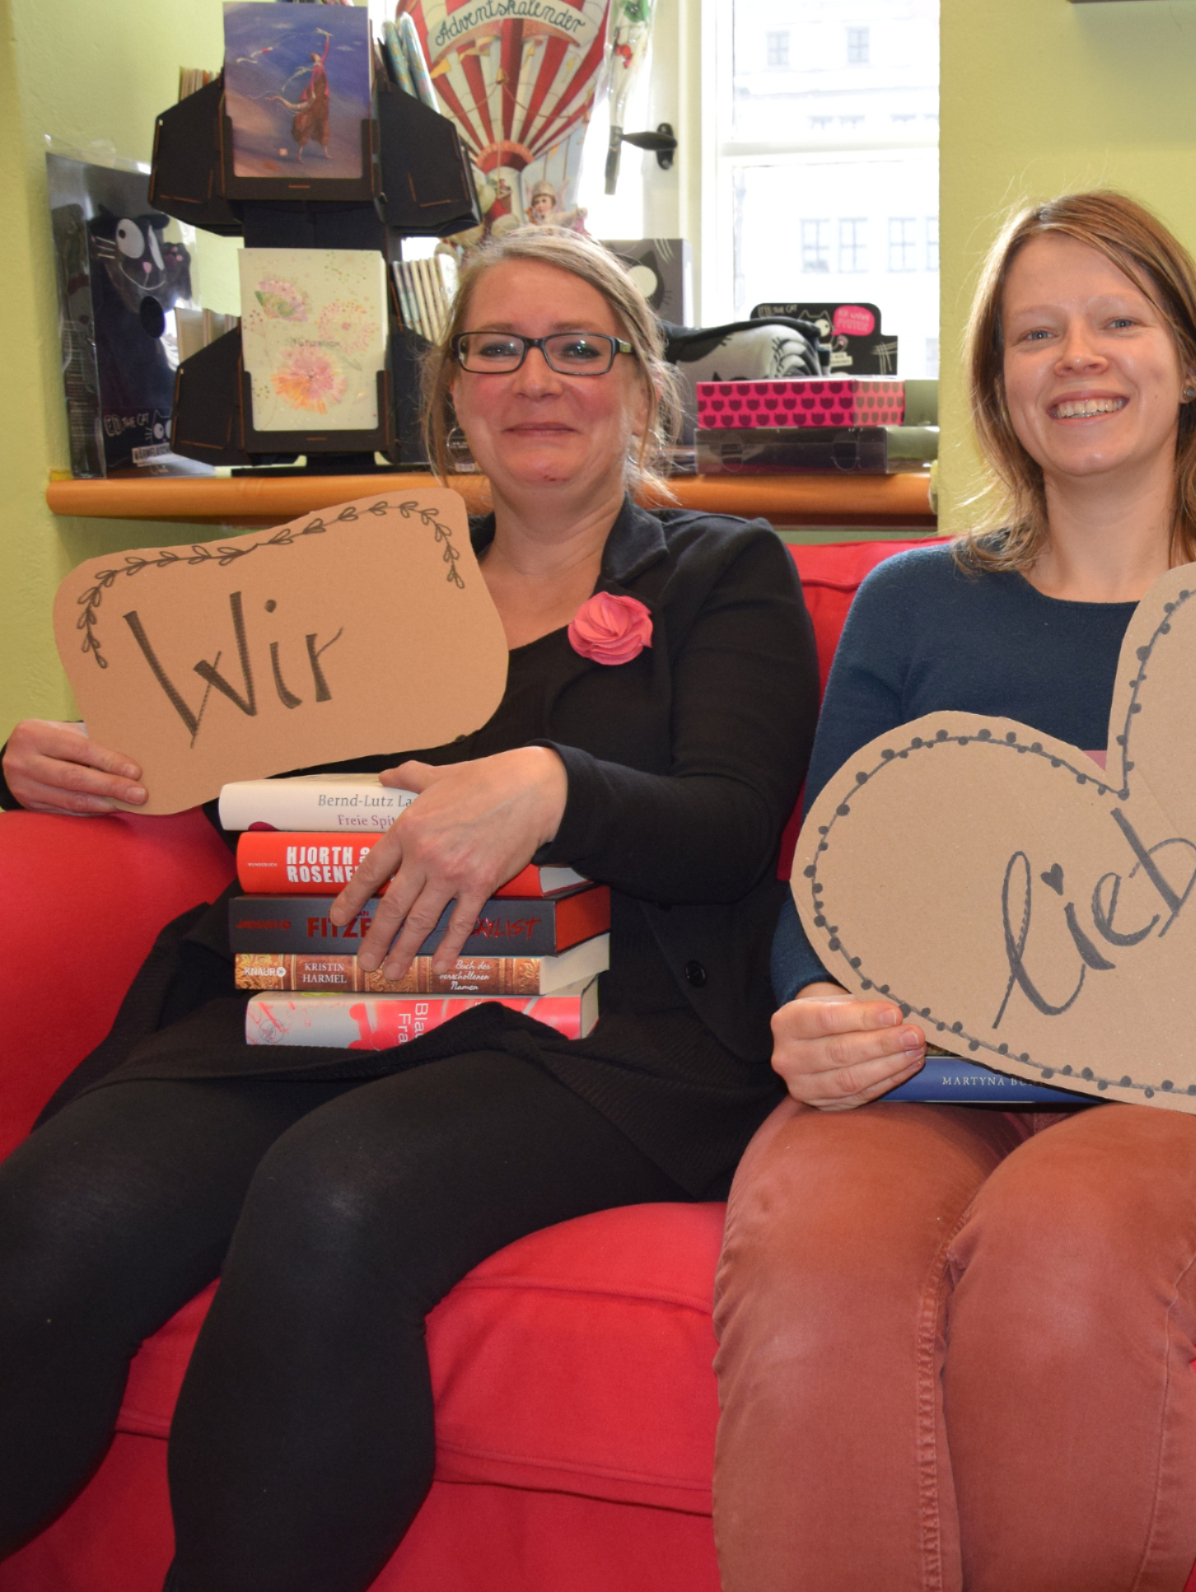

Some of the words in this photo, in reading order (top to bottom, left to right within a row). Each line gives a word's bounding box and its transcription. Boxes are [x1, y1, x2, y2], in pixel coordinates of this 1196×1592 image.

[434, 0, 586, 46] Adventskalender
[122, 591, 343, 749] Wir
[318, 794, 393, 807] Bernd-Lutz
[398, 795, 412, 807] La
[338, 815, 368, 826] Freie
[371, 815, 395, 829] Spit
[286, 846, 353, 865] HJORTH
[286, 866, 358, 883] ROSENE
[307, 918, 373, 938] FITZE
[244, 967, 276, 976] KNAUR
[305, 963, 345, 972] KRISTIN
[455, 960, 475, 970] Buch
[477, 961, 492, 970] der
[303, 974, 347, 983] HARMEL
[450, 981, 478, 990] Namen
[414, 1003, 428, 1038] Bla
[398, 1013, 411, 1043] Fra
[942, 1077, 1005, 1086] MARTYNA
